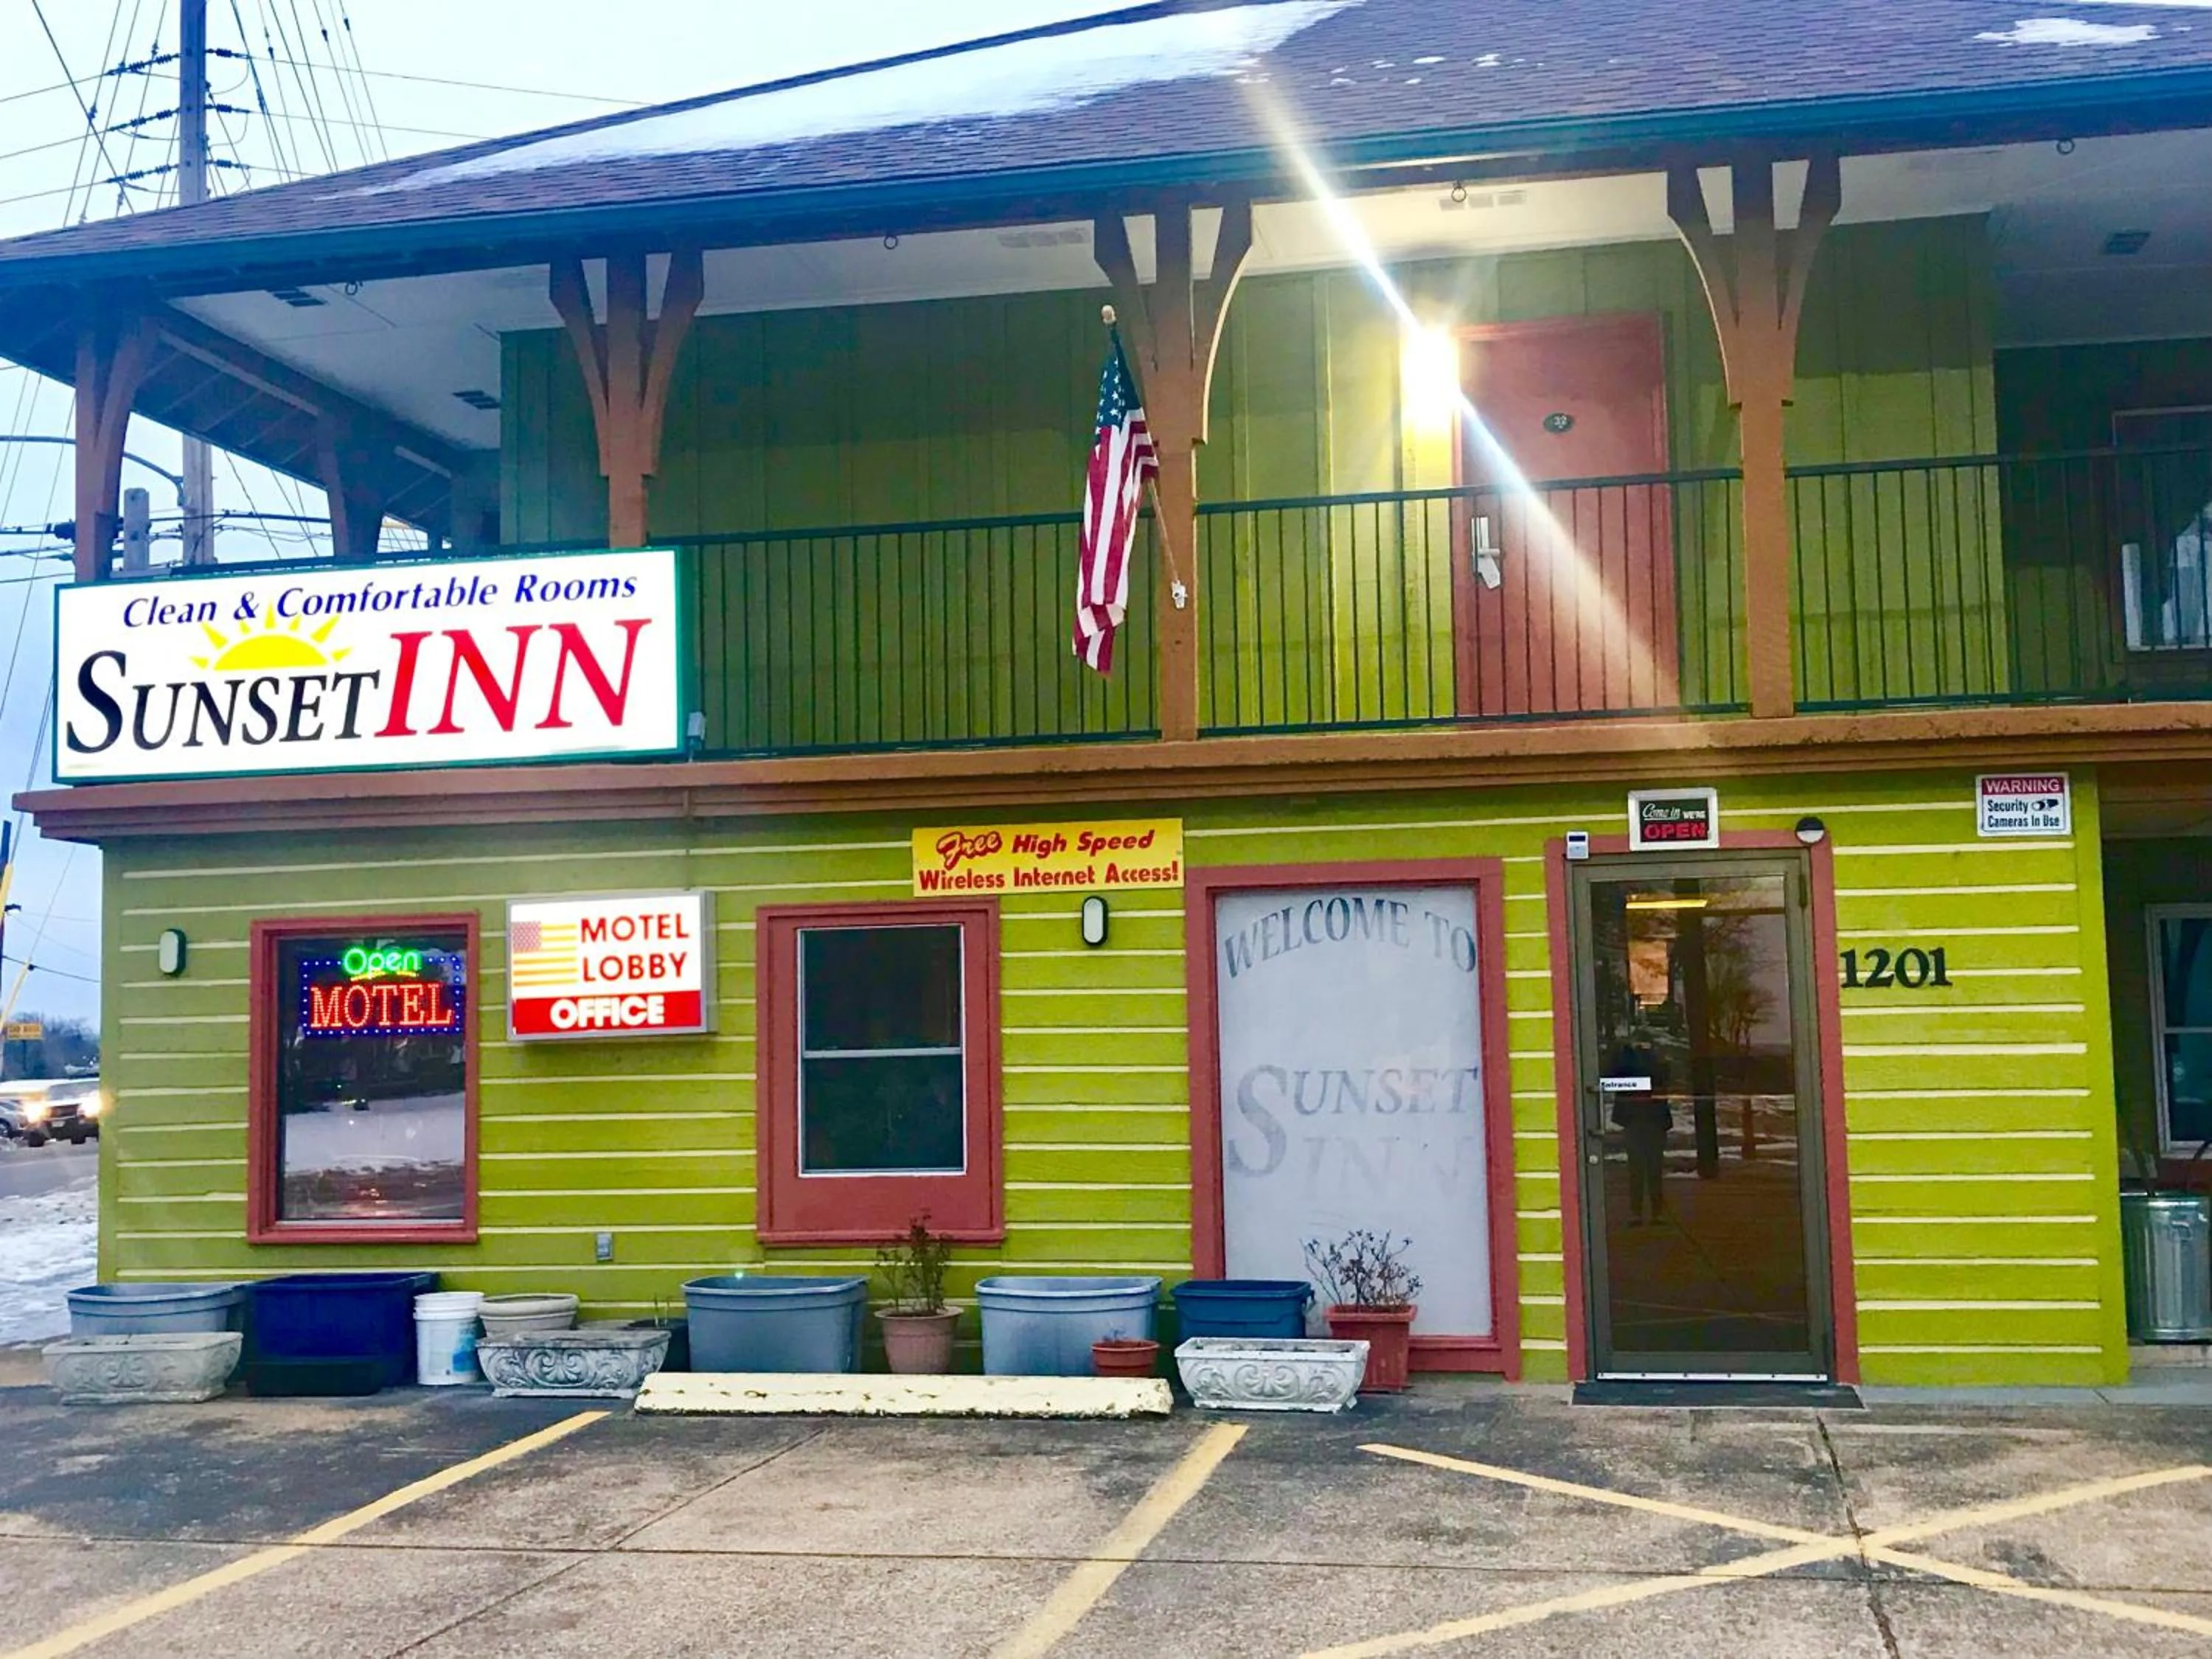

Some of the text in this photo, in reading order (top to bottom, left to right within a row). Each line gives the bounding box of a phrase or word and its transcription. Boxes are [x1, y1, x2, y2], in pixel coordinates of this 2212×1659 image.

[124, 574, 638, 627] Clean & Comfortable Rooms
[66, 619, 653, 754] SUNSET INN
[1985, 779, 2060, 793] WARNING
[1987, 799, 2028, 813] Security
[1987, 815, 2060, 828] Cameras In Use
[1644, 822, 1705, 839] OPEN
[935, 830, 1155, 871] Free High Speed
[919, 860, 1179, 891] Wireless Internet Access!
[581, 914, 689, 943] MOTEL
[1224, 897, 1477, 979] WELCOME TO
[343, 947, 420, 981] Open
[582, 952, 688, 982] LOBBY
[1840, 947, 1953, 989] 1201
[310, 983, 455, 1029] MOTEL
[550, 995, 665, 1029] OFFICE
[1227, 1064, 1478, 1179] SUNSET
